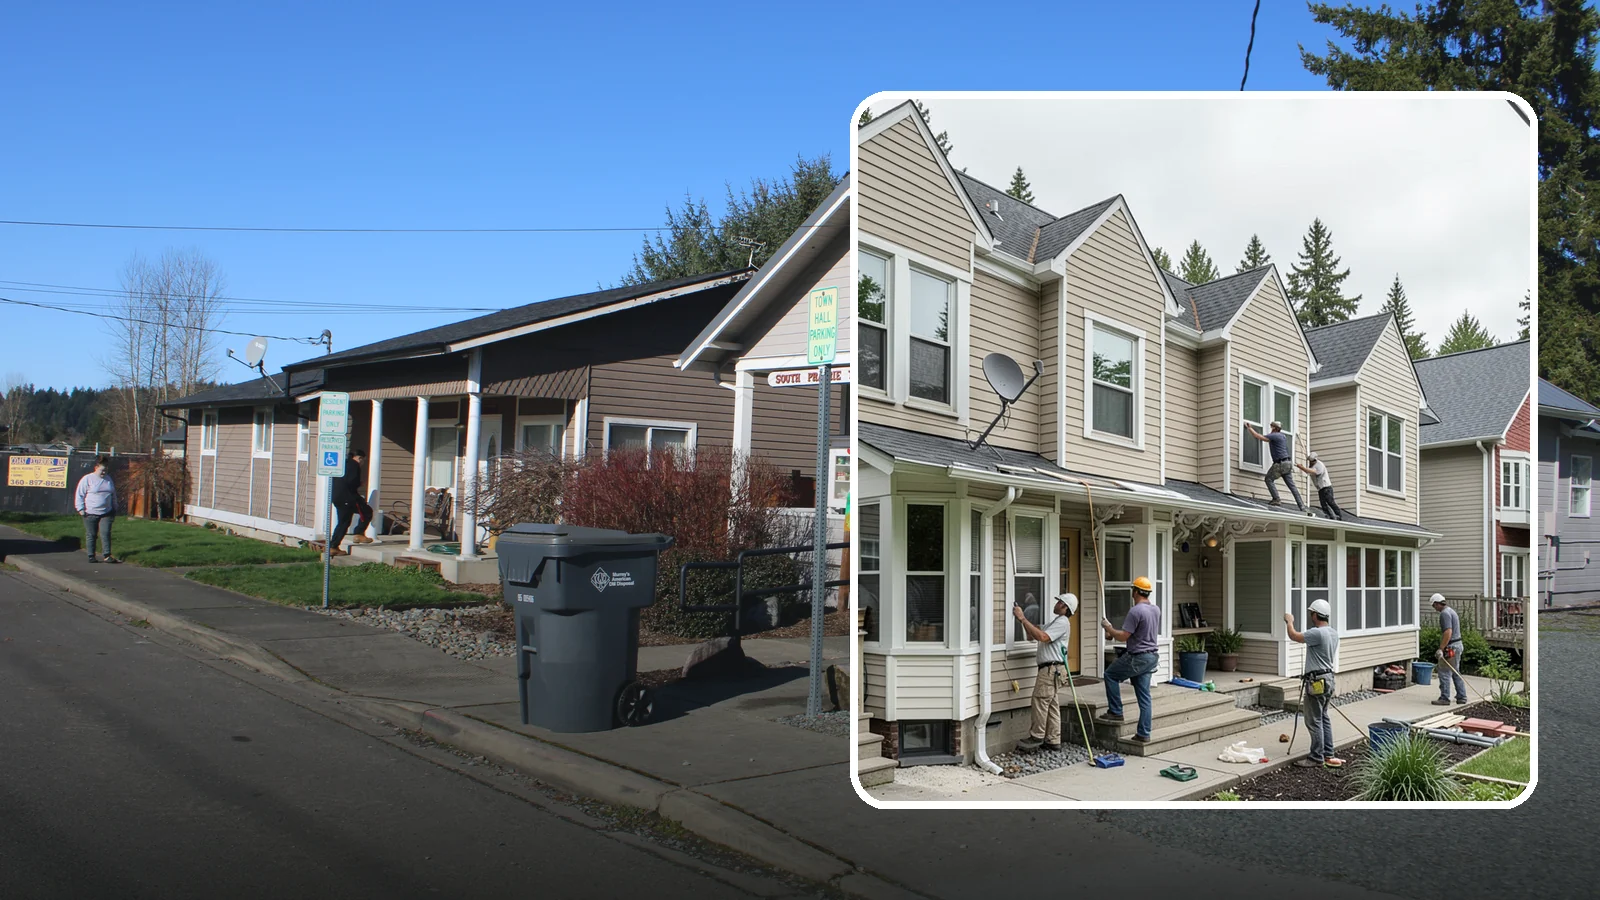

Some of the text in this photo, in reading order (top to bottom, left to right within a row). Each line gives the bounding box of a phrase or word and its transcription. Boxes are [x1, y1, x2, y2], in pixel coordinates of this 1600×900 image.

[815, 295, 833, 307] TOWN
[814, 312, 831, 324] HALL
[810, 327, 835, 340] PARKING
[813, 344, 831, 357] ONLY
[775, 373, 801, 384] SOUTH
[808, 371, 841, 382] PRIE
